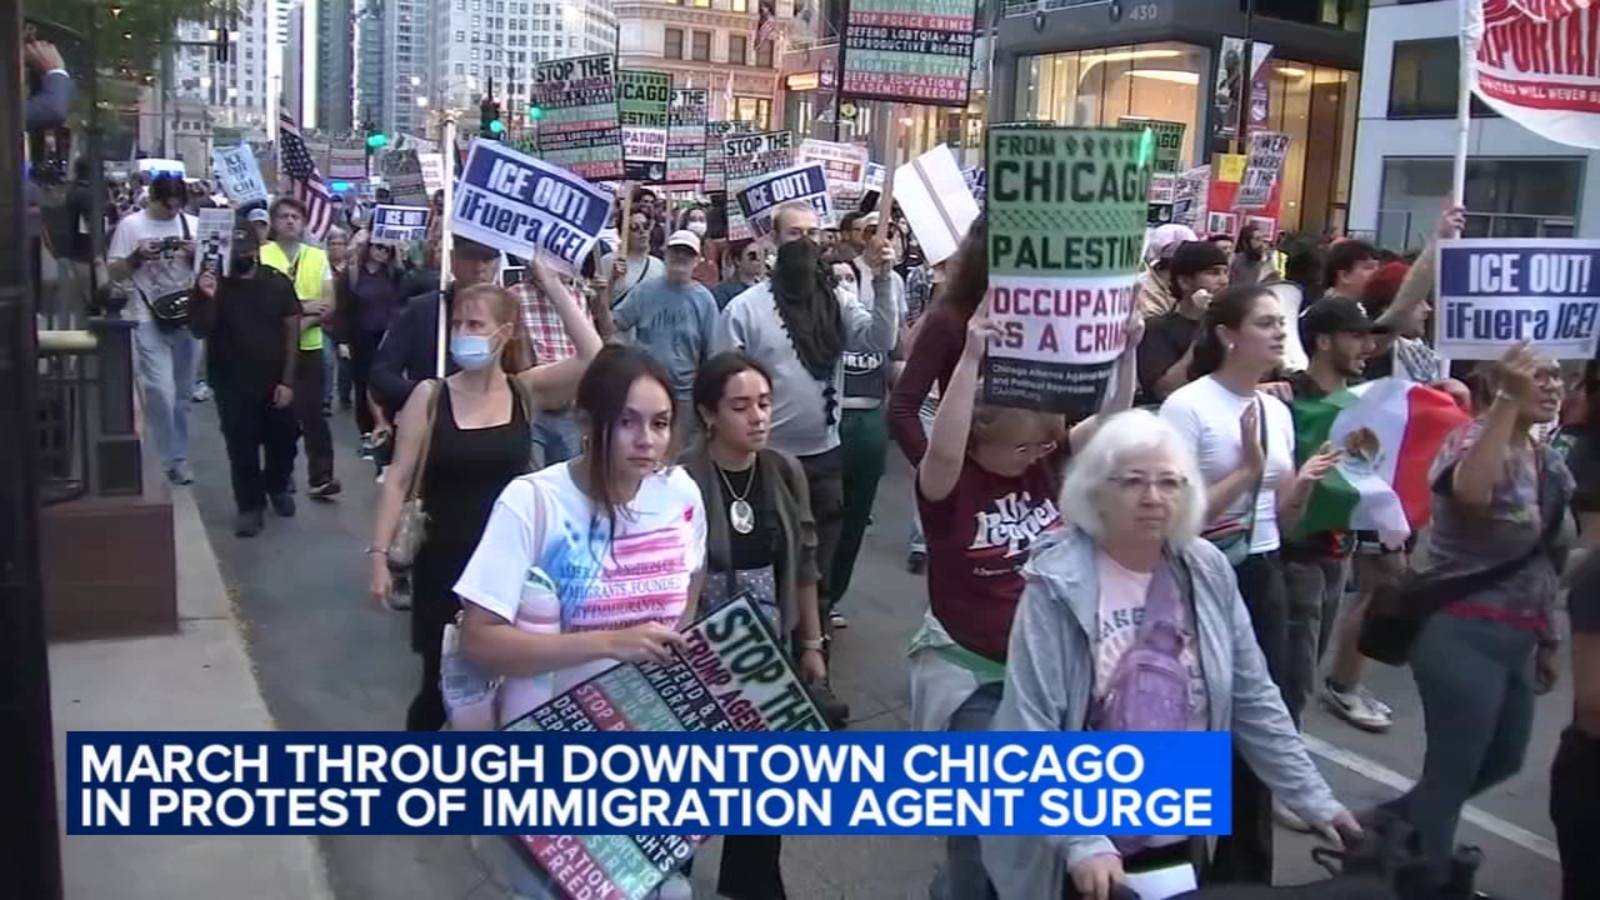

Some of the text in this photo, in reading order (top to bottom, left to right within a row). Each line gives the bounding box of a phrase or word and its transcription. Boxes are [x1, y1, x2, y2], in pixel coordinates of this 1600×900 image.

[848, 11, 974, 31] STOP POLICE CRIMES
[1129, 5, 1157, 20] 430
[845, 37, 971, 56] REPRODUCTIVE RIGHTS
[846, 26, 974, 44] DEFEND LGBTQIA+ AND
[536, 57, 611, 82] STOP THE
[844, 71, 885, 83] DEFEND
[889, 74, 955, 89] EDUCATION
[616, 83, 668, 101] ICAGO
[842, 80, 967, 100] ACADEMIC FREEDOM
[619, 112, 666, 127] ESTINE
[624, 131, 665, 144] PATION
[727, 133, 790, 156] STOP THE
[995, 135, 1055, 157] FROM
[486, 158, 532, 199] ICE
[533, 174, 588, 224] OUT!
[746, 172, 812, 212] ICE OUT!
[543, 222, 585, 264] ICE!
[1469, 254, 1591, 293] ICE OUT!
[993, 287, 1132, 317] OCCUPATIO
[1552, 302, 1598, 340] ICE!
[1039, 324, 1058, 352] A
[1075, 323, 1132, 352] CRIM
[843, 354, 879, 369] RLD
[706, 608, 784, 684] STOP
[687, 628, 732, 686] TRUMP
[717, 689, 768, 731] AGEN
[576, 679, 614, 723] STOP
[699, 702, 717, 718] &
[610, 835, 642, 868] GHTS
[635, 835, 676, 875] GHTS
[538, 839, 594, 900] FREED
[550, 835, 617, 900] CATION
